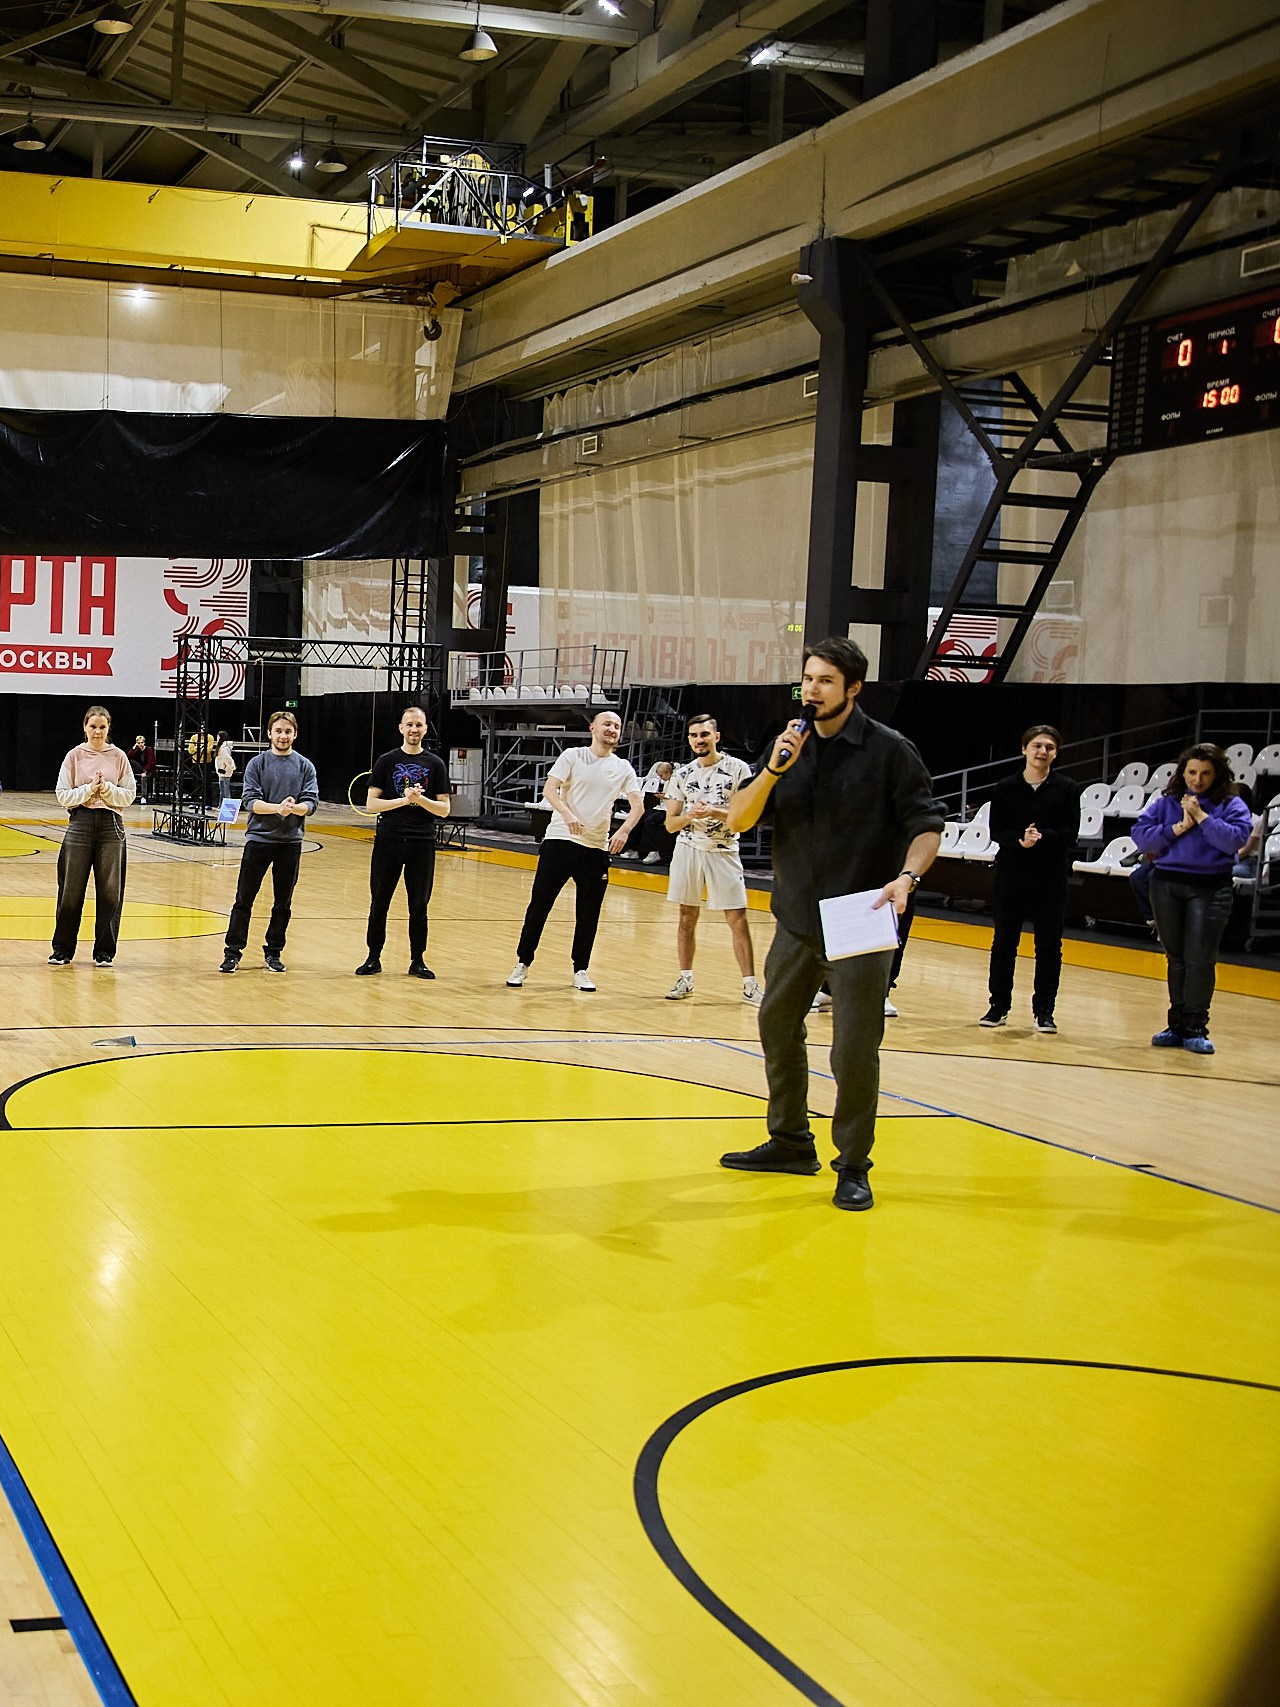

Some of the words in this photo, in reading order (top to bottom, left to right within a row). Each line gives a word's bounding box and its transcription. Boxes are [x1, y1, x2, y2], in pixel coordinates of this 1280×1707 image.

[1167, 333, 1183, 343] СЧЕТ
[1208, 327, 1235, 339] ПЕРИОД
[1221, 339, 1229, 354] 1
[1178, 339, 1192, 366] 0
[1206, 378, 1230, 389] ВРЕМЯ
[1255, 392, 1277, 401] ФОЛЫ
[1161, 411, 1180, 421] ФОЛЫ
